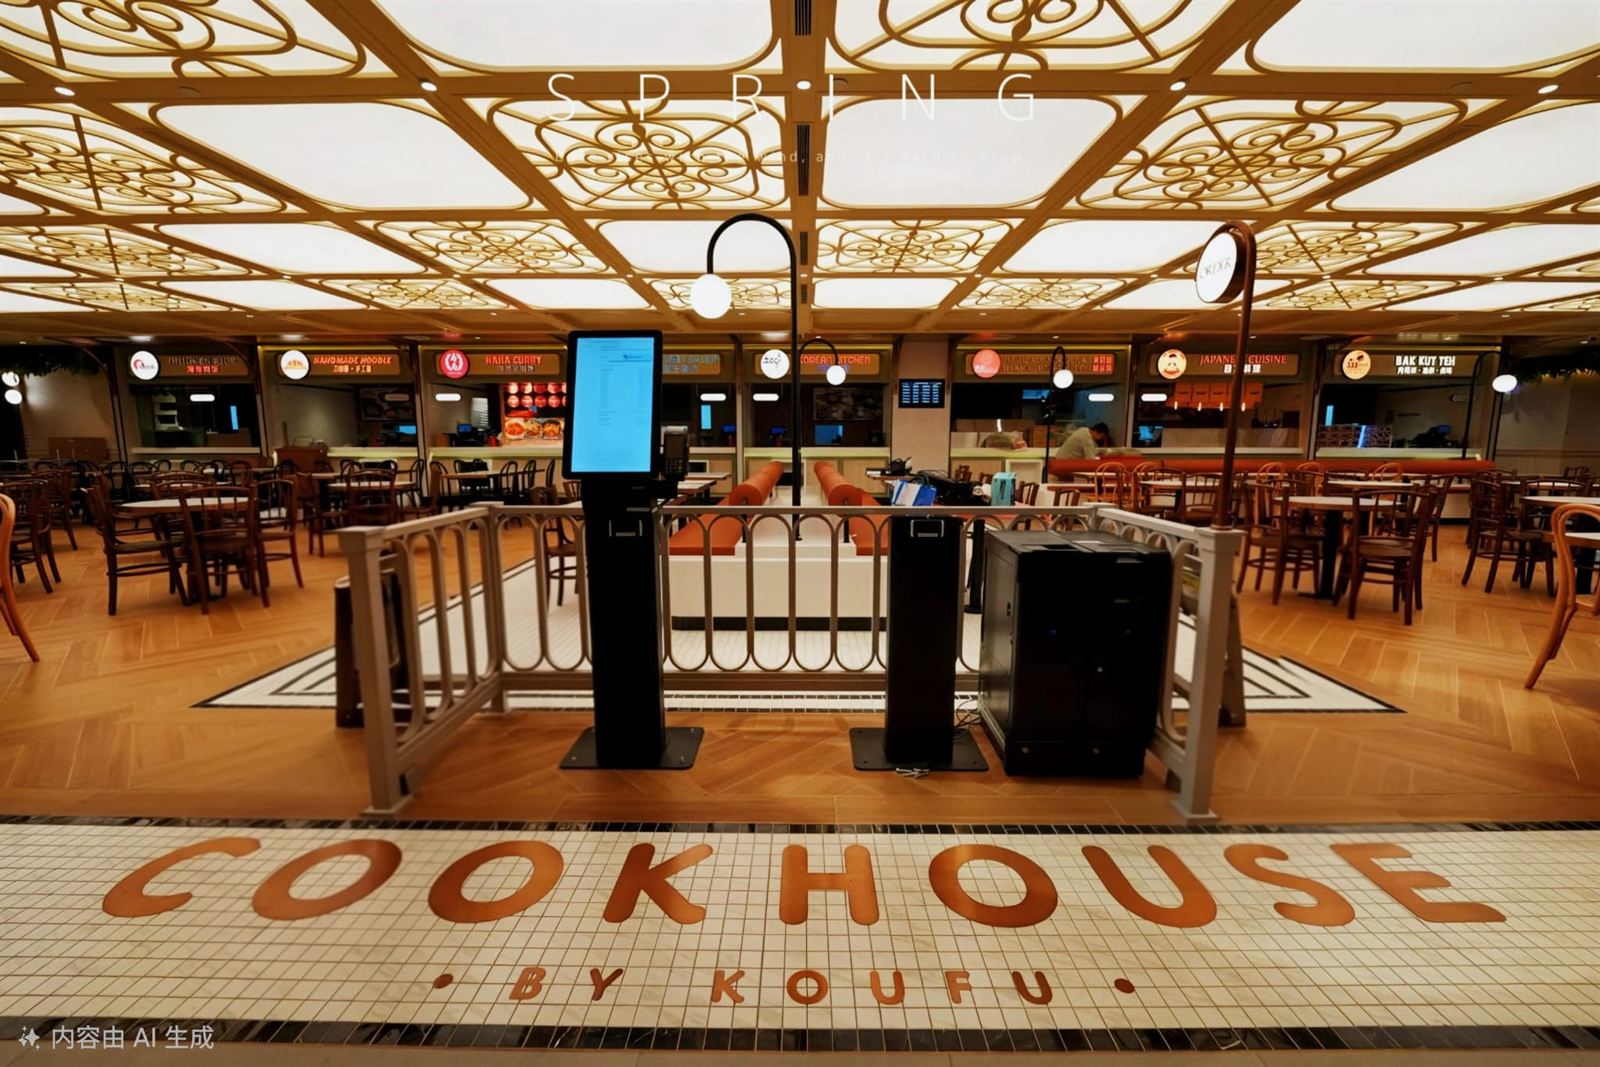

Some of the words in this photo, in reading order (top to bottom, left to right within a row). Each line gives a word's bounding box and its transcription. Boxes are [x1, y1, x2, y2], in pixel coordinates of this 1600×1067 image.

[313, 356, 359, 364] HANDMADE
[360, 356, 392, 364] NOODLE
[513, 355, 542, 364] CURRY
[1200, 354, 1236, 367] JAPANE
[1248, 354, 1288, 364] CUISINE
[1396, 355, 1417, 366] BAK
[1418, 355, 1437, 366] KUT
[1438, 355, 1456, 366] TEH
[102, 836, 1506, 930] COOKHOUSE
[509, 966, 624, 1004] BY
[710, 968, 1053, 1006] KOUFU
